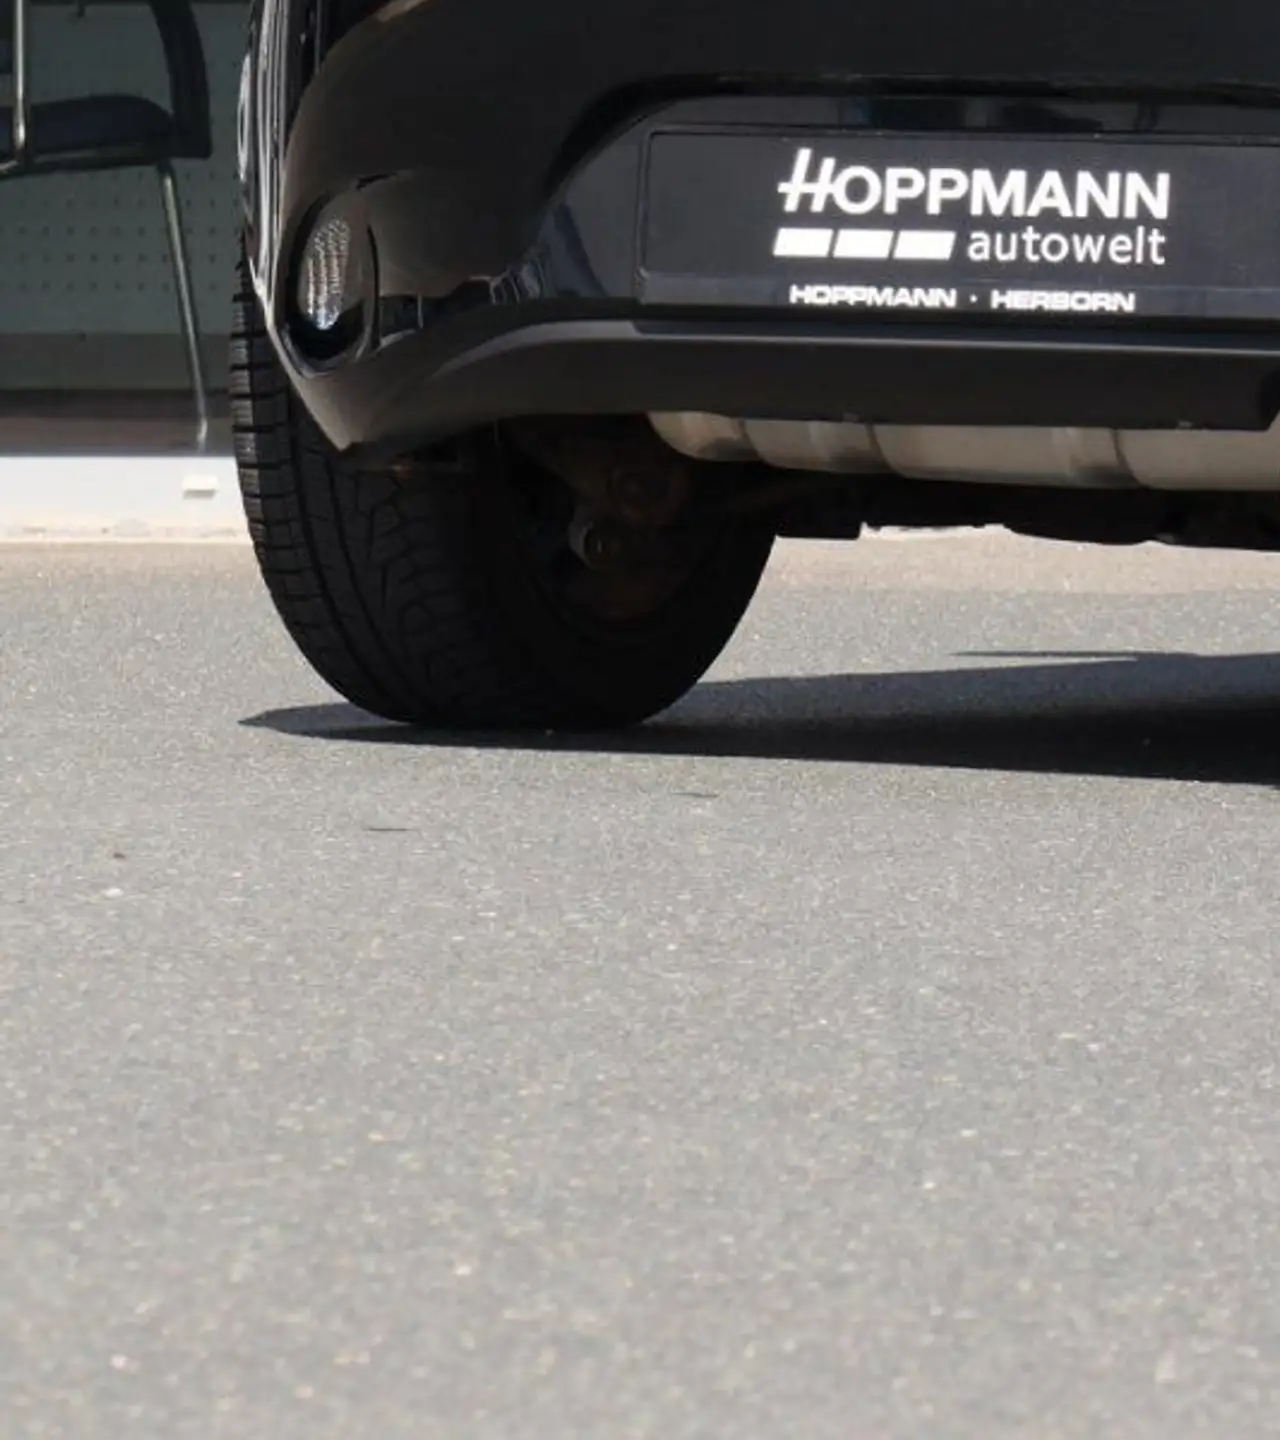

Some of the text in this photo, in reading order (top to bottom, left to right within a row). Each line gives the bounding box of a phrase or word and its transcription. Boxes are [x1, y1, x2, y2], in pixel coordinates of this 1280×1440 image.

[776, 147, 1171, 220] HOPPMANN
[966, 224, 1167, 266] autowelt
[788, 283, 1137, 313] HOPPMANN HERBORN
